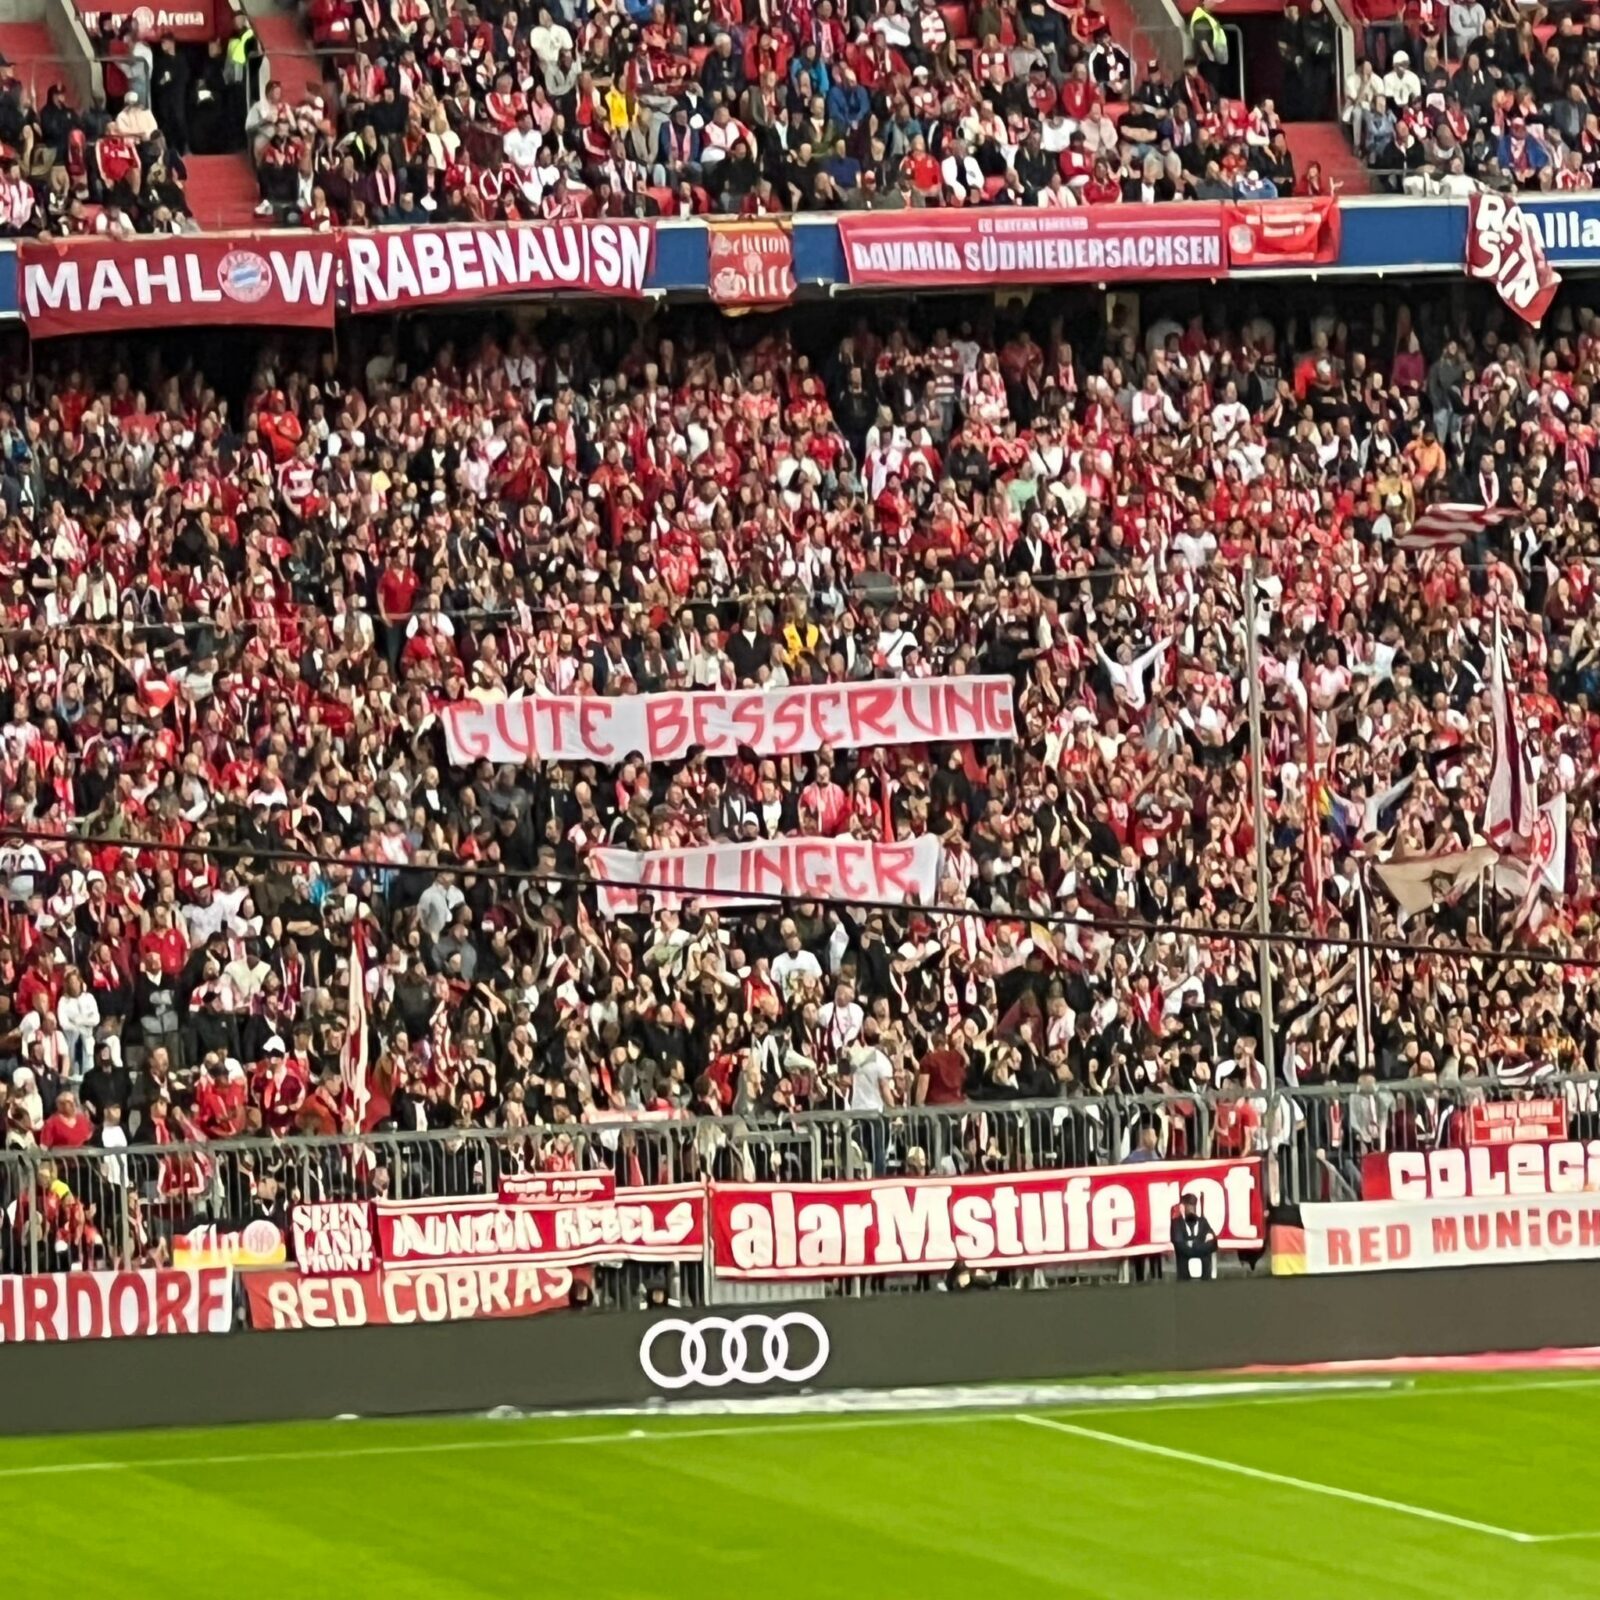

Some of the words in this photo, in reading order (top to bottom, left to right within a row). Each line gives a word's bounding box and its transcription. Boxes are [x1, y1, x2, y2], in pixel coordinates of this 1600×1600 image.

[157, 9, 205, 27] Arena
[852, 240, 962, 272] BAVARIA
[964, 234, 1220, 272] SÜDNIEDERSACHSEN
[450, 697, 614, 757] GUTE
[646, 682, 1013, 757] BESSERUNG
[293, 1203, 369, 1231] SEEN
[555, 1202, 694, 1249] REBELS
[731, 1177, 1135, 1269] alarMstufe
[1148, 1166, 1258, 1243] rot
[293, 1225, 372, 1257] LAND
[1326, 1223, 1411, 1266] RED
[298, 1250, 374, 1274] FRONT
[269, 1277, 367, 1330] RED
[383, 1266, 574, 1325] COBRAS
